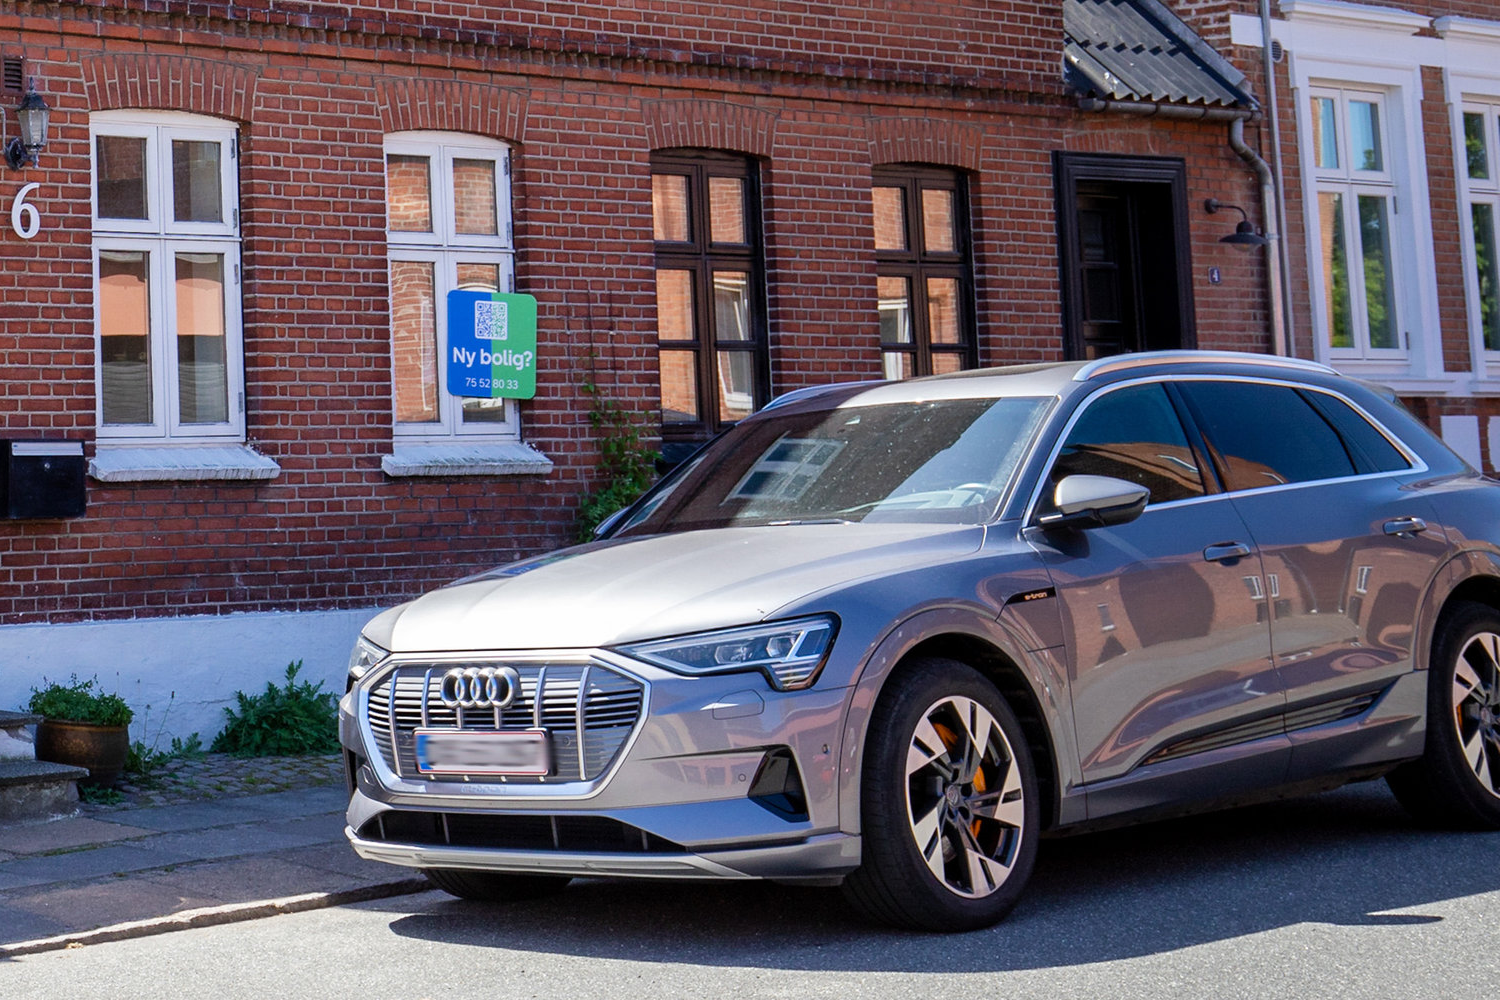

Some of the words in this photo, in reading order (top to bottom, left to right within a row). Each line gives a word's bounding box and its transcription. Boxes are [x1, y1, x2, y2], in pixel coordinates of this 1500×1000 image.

[11, 182, 40, 239] 6
[452, 346, 476, 368] Ny
[480, 348, 533, 371] bolig?
[465, 377, 477, 388] 75
[479, 378, 491, 389] 52
[492, 379, 505, 389] 80
[506, 380, 519, 390] 33
